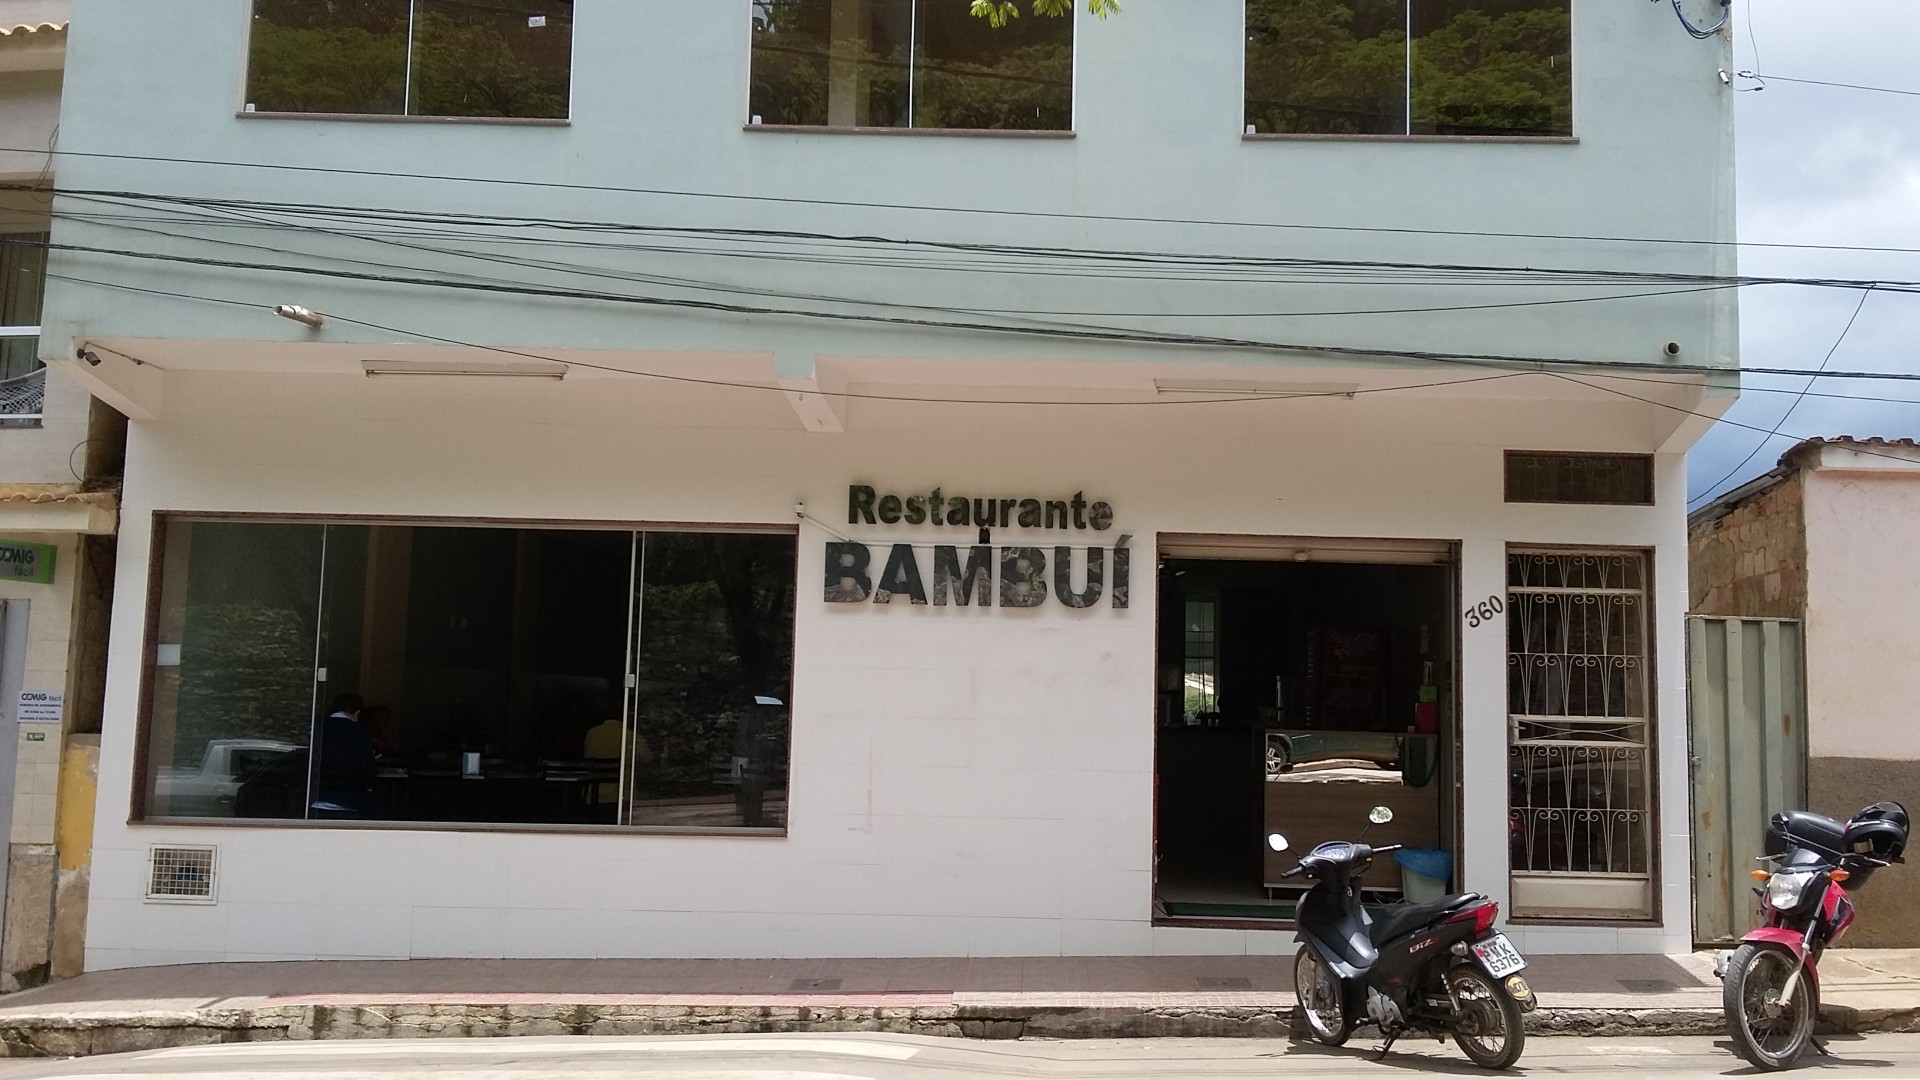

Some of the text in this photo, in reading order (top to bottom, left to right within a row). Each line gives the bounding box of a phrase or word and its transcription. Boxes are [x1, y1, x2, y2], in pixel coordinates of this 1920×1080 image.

[848, 485, 1113, 531] Restaurante
[824, 534, 1133, 609] BAMBUÍ
[1464, 595, 1503, 628] 360
[1489, 953, 1520, 973] 6376
